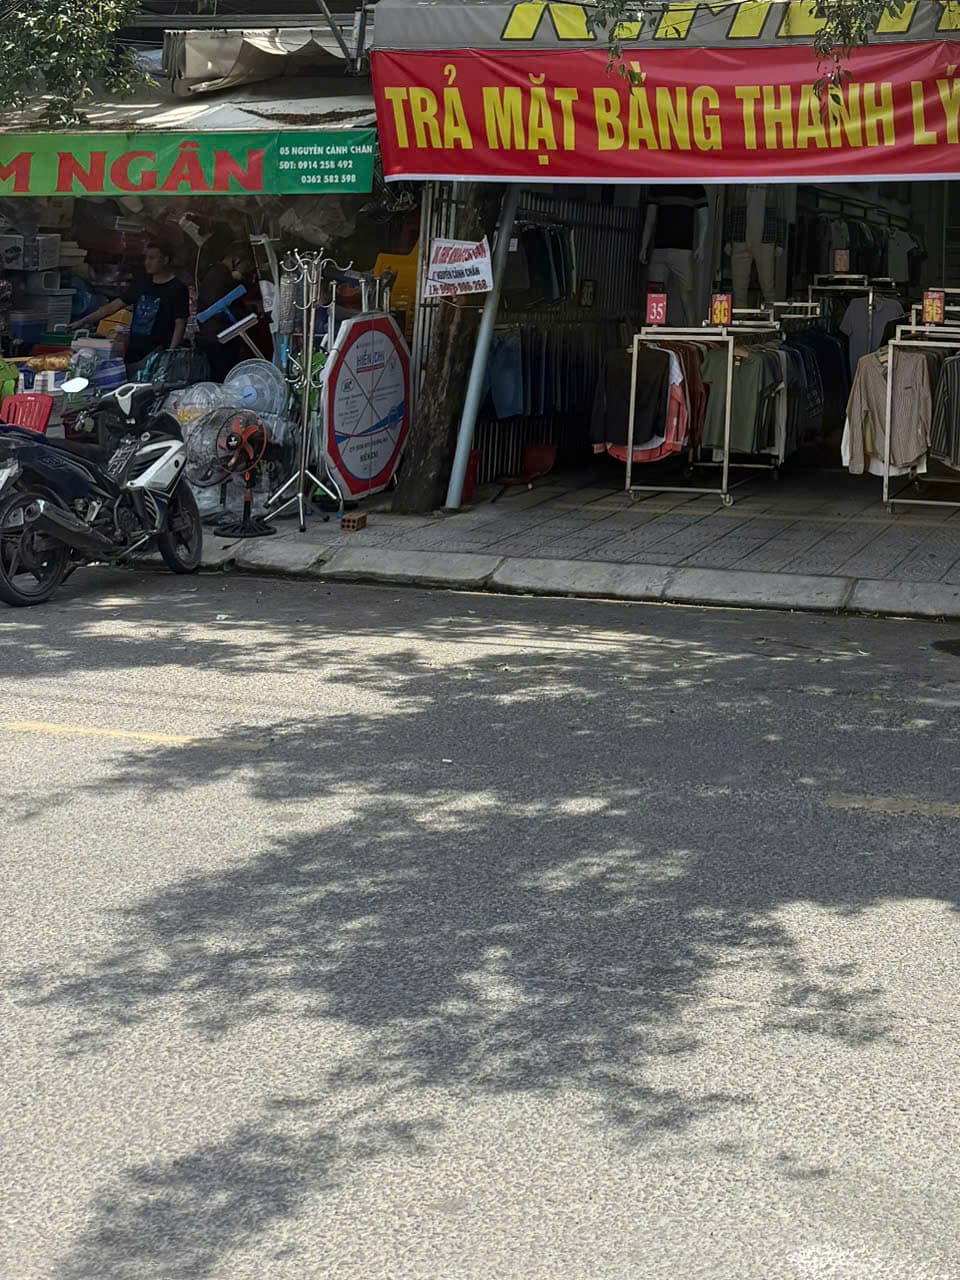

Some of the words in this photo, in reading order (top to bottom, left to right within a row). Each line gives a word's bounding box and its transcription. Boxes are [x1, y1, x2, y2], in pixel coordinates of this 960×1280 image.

[384, 64, 473, 150] TRẢ
[482, 72, 579, 166] MẶT
[593, 61, 723, 152] BẰNG
[735, 81, 896, 150] THANH
[55, 140, 266, 194] NGÂN
[297, 160, 318, 169] 0914
[337, 160, 353, 169] 492
[301, 175, 322, 184] 0362
[323, 174, 339, 183] 582
[341, 174, 356, 183] 598
[650, 302, 663, 320] 35
